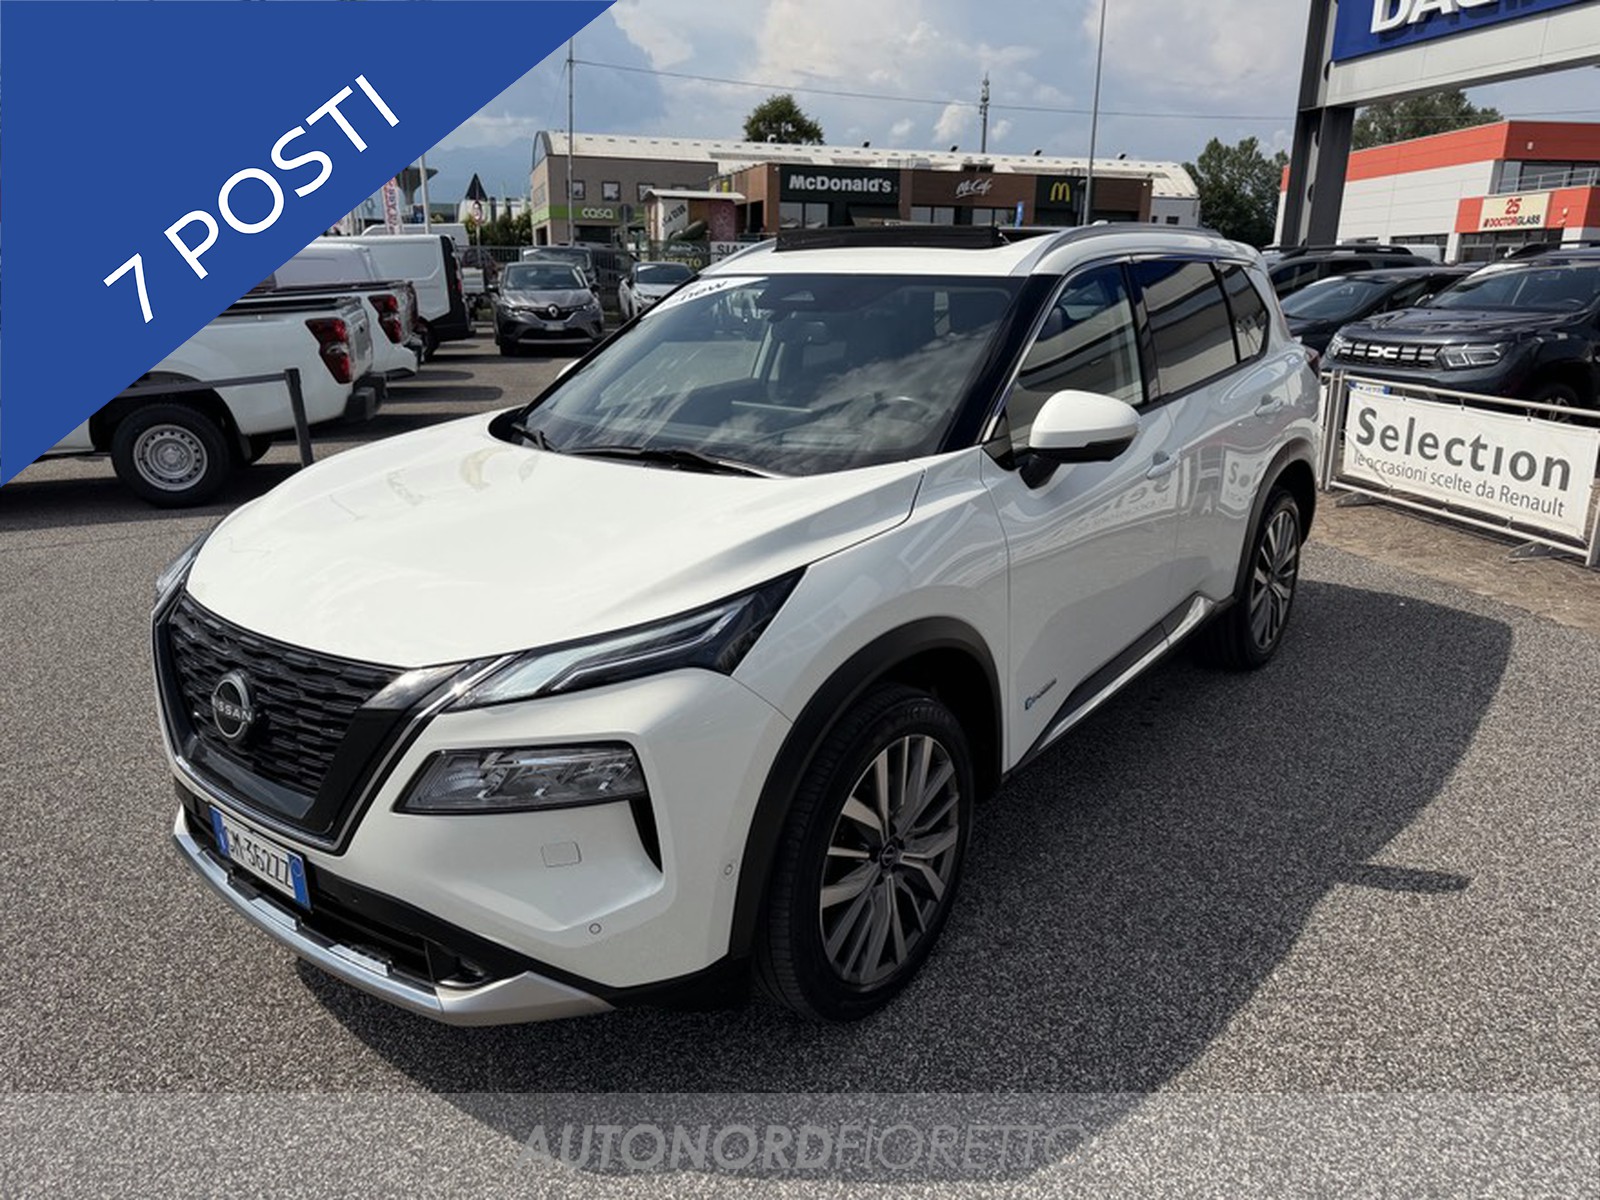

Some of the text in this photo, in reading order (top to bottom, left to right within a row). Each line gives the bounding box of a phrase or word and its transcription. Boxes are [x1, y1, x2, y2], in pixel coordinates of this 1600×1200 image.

[789, 174, 892, 194] McDonald's
[582, 207, 613, 219] casa
[1505, 197, 1522, 215] 25
[1356, 407, 1571, 491] Selection
[1365, 455, 1428, 483] occasioni
[1430, 469, 1471, 495] scelte
[1475, 480, 1495, 501] da
[1499, 484, 1565, 518] Renault
[213, 698, 252, 721] SSAN
